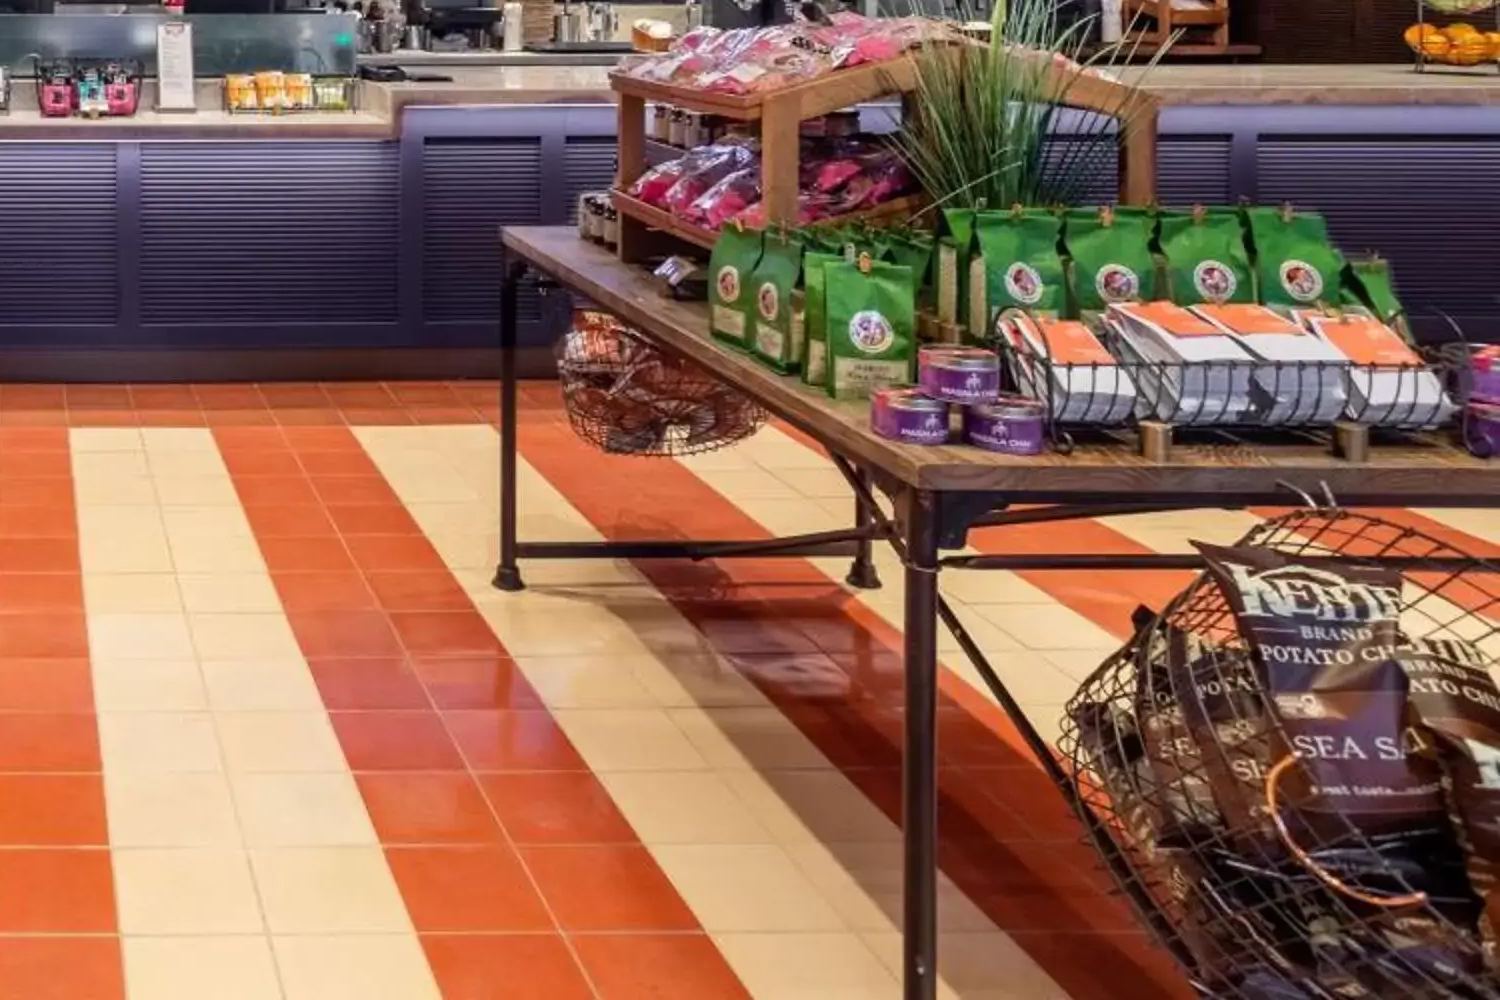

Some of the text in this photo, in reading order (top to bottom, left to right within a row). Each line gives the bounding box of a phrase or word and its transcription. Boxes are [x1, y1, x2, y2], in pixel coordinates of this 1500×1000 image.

[1301, 625, 1373, 642] BRAND
[1258, 643, 1354, 666] POTATO
[1292, 734, 1367, 760] SEA
